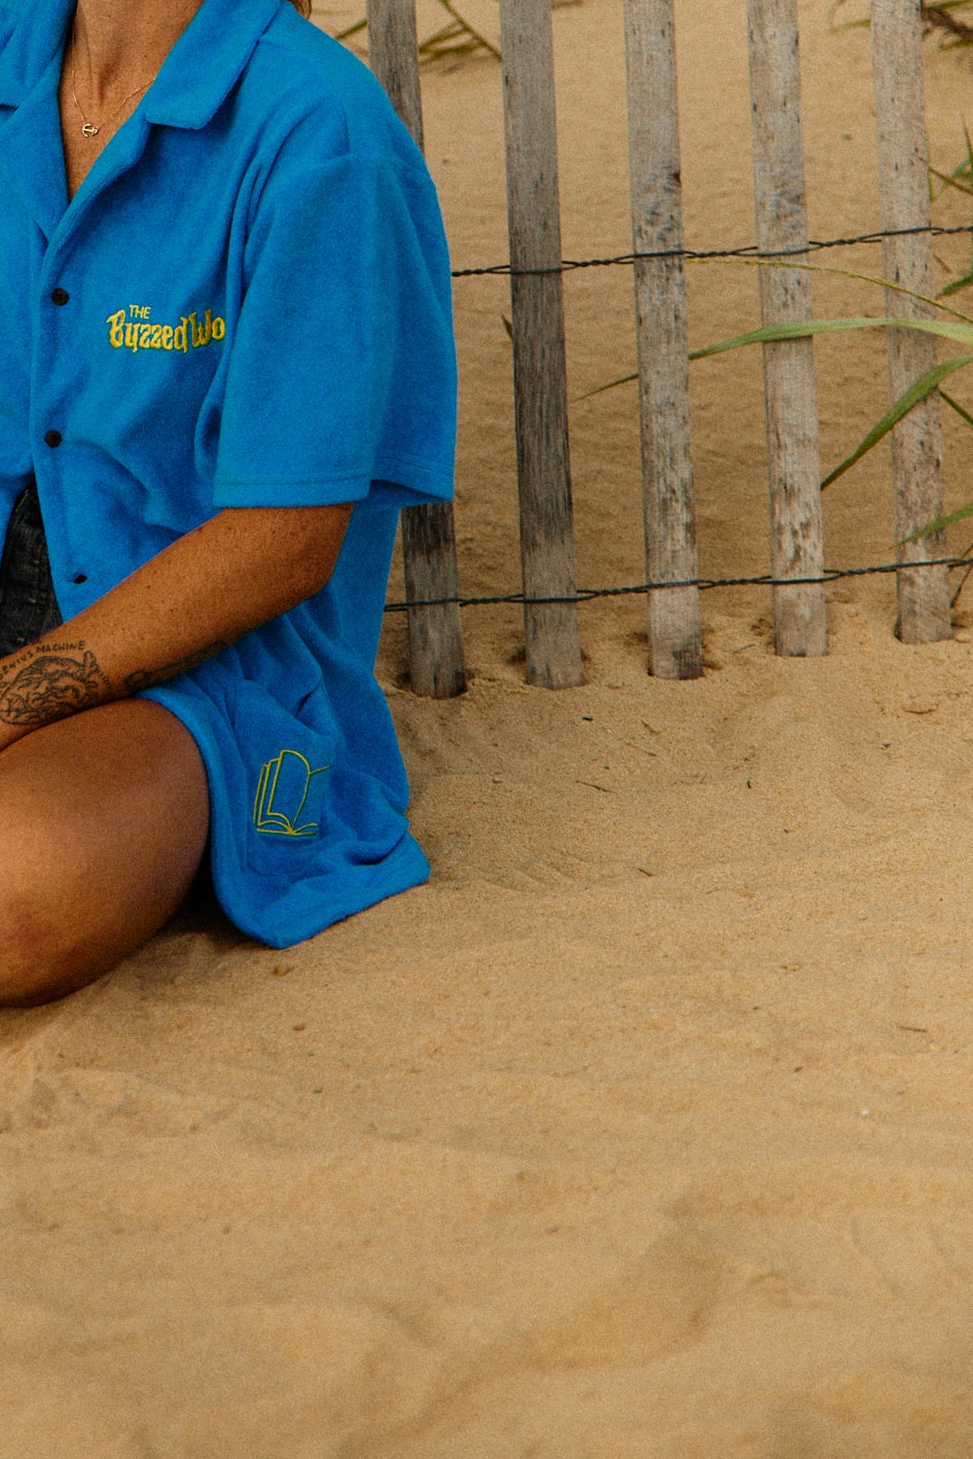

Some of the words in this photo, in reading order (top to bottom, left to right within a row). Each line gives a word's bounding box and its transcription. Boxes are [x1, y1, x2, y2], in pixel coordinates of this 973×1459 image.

[129, 304, 152, 319] THE
[106, 309, 189, 354] Buzzed
[36, 640, 86, 653] MACHINE
